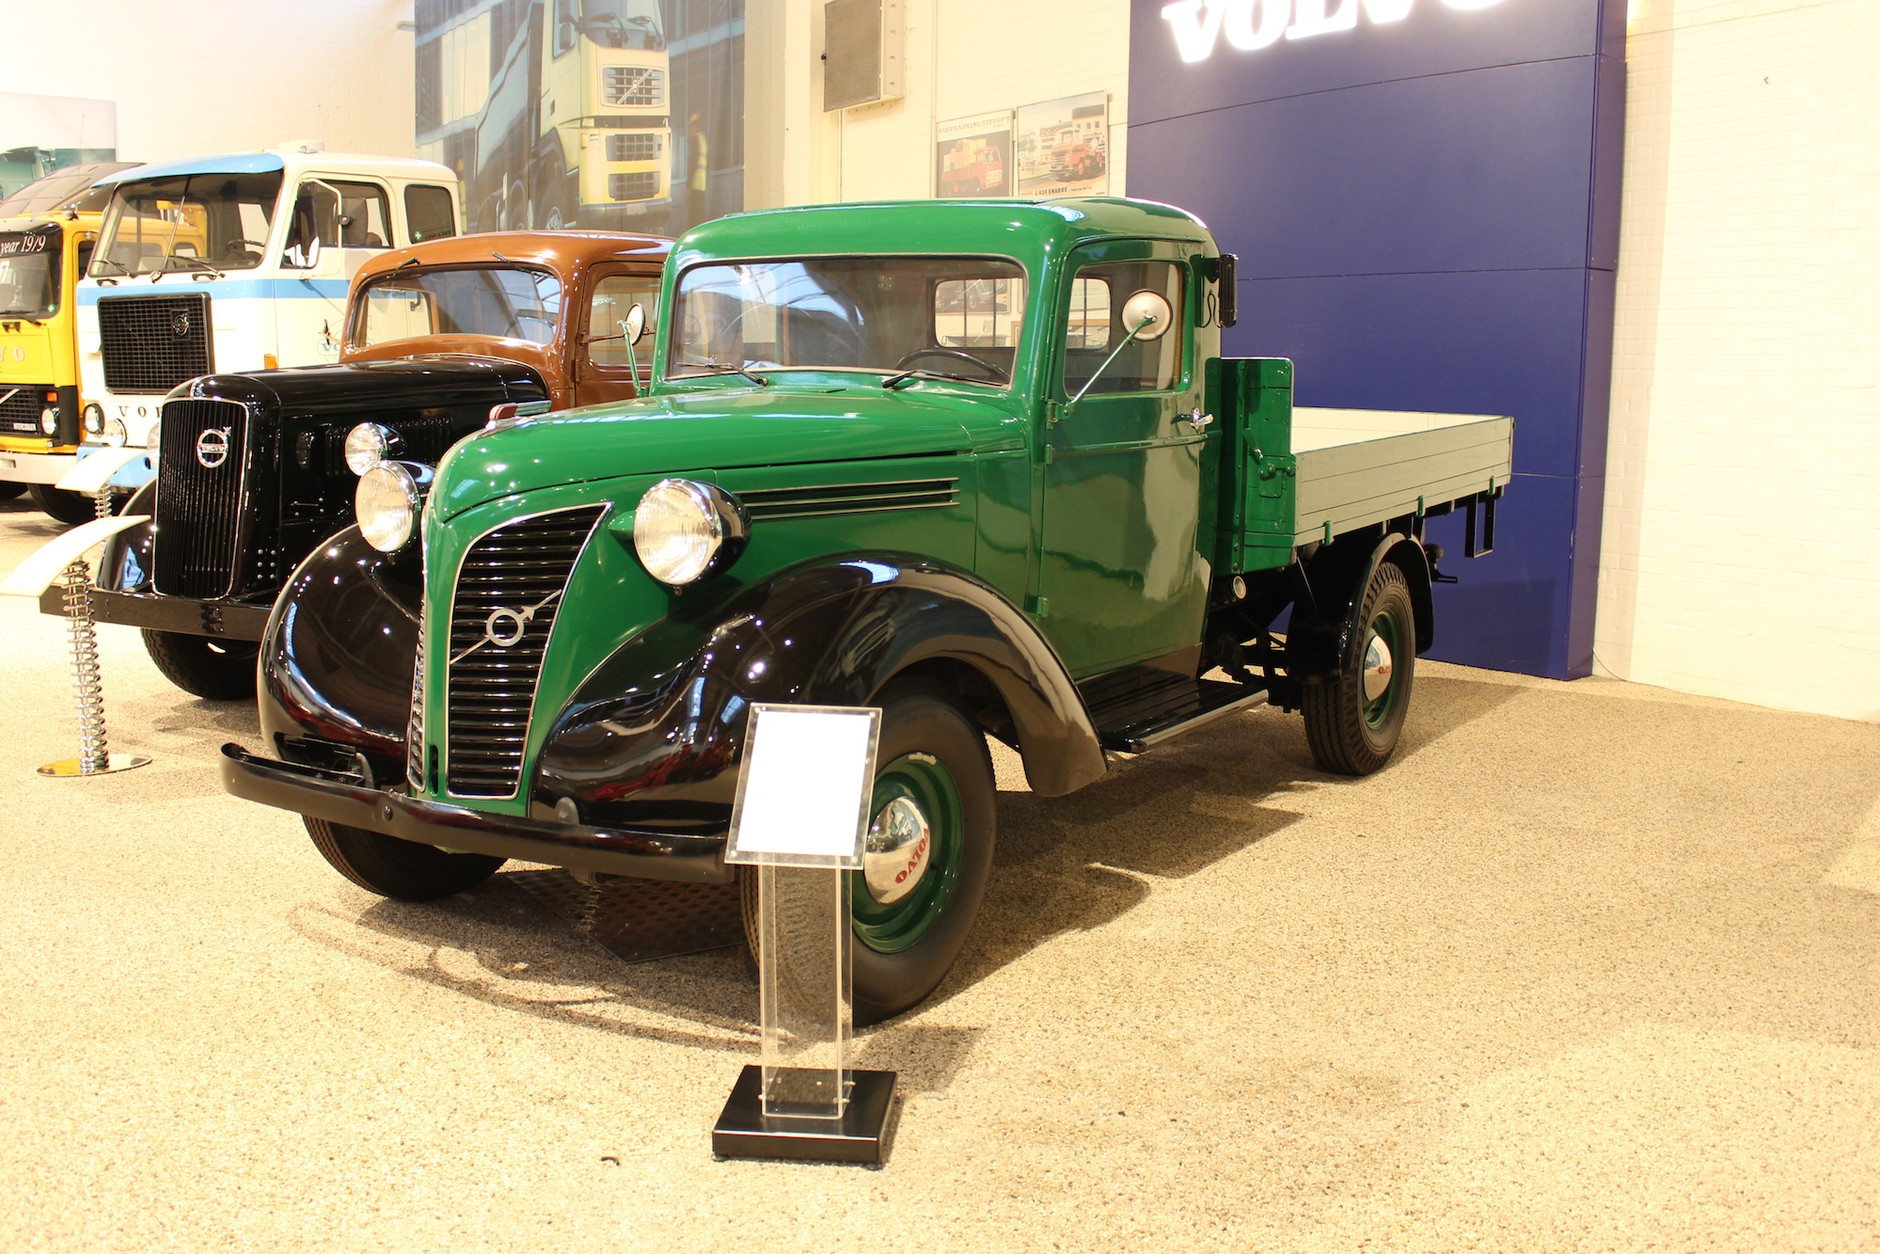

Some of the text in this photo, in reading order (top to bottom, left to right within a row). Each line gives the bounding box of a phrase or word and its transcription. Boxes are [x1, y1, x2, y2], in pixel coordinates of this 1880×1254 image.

[1162, 0, 1500, 63] VOL
[0, 236, 46, 257] year 1979
[895, 828, 929, 884] VOLVO
